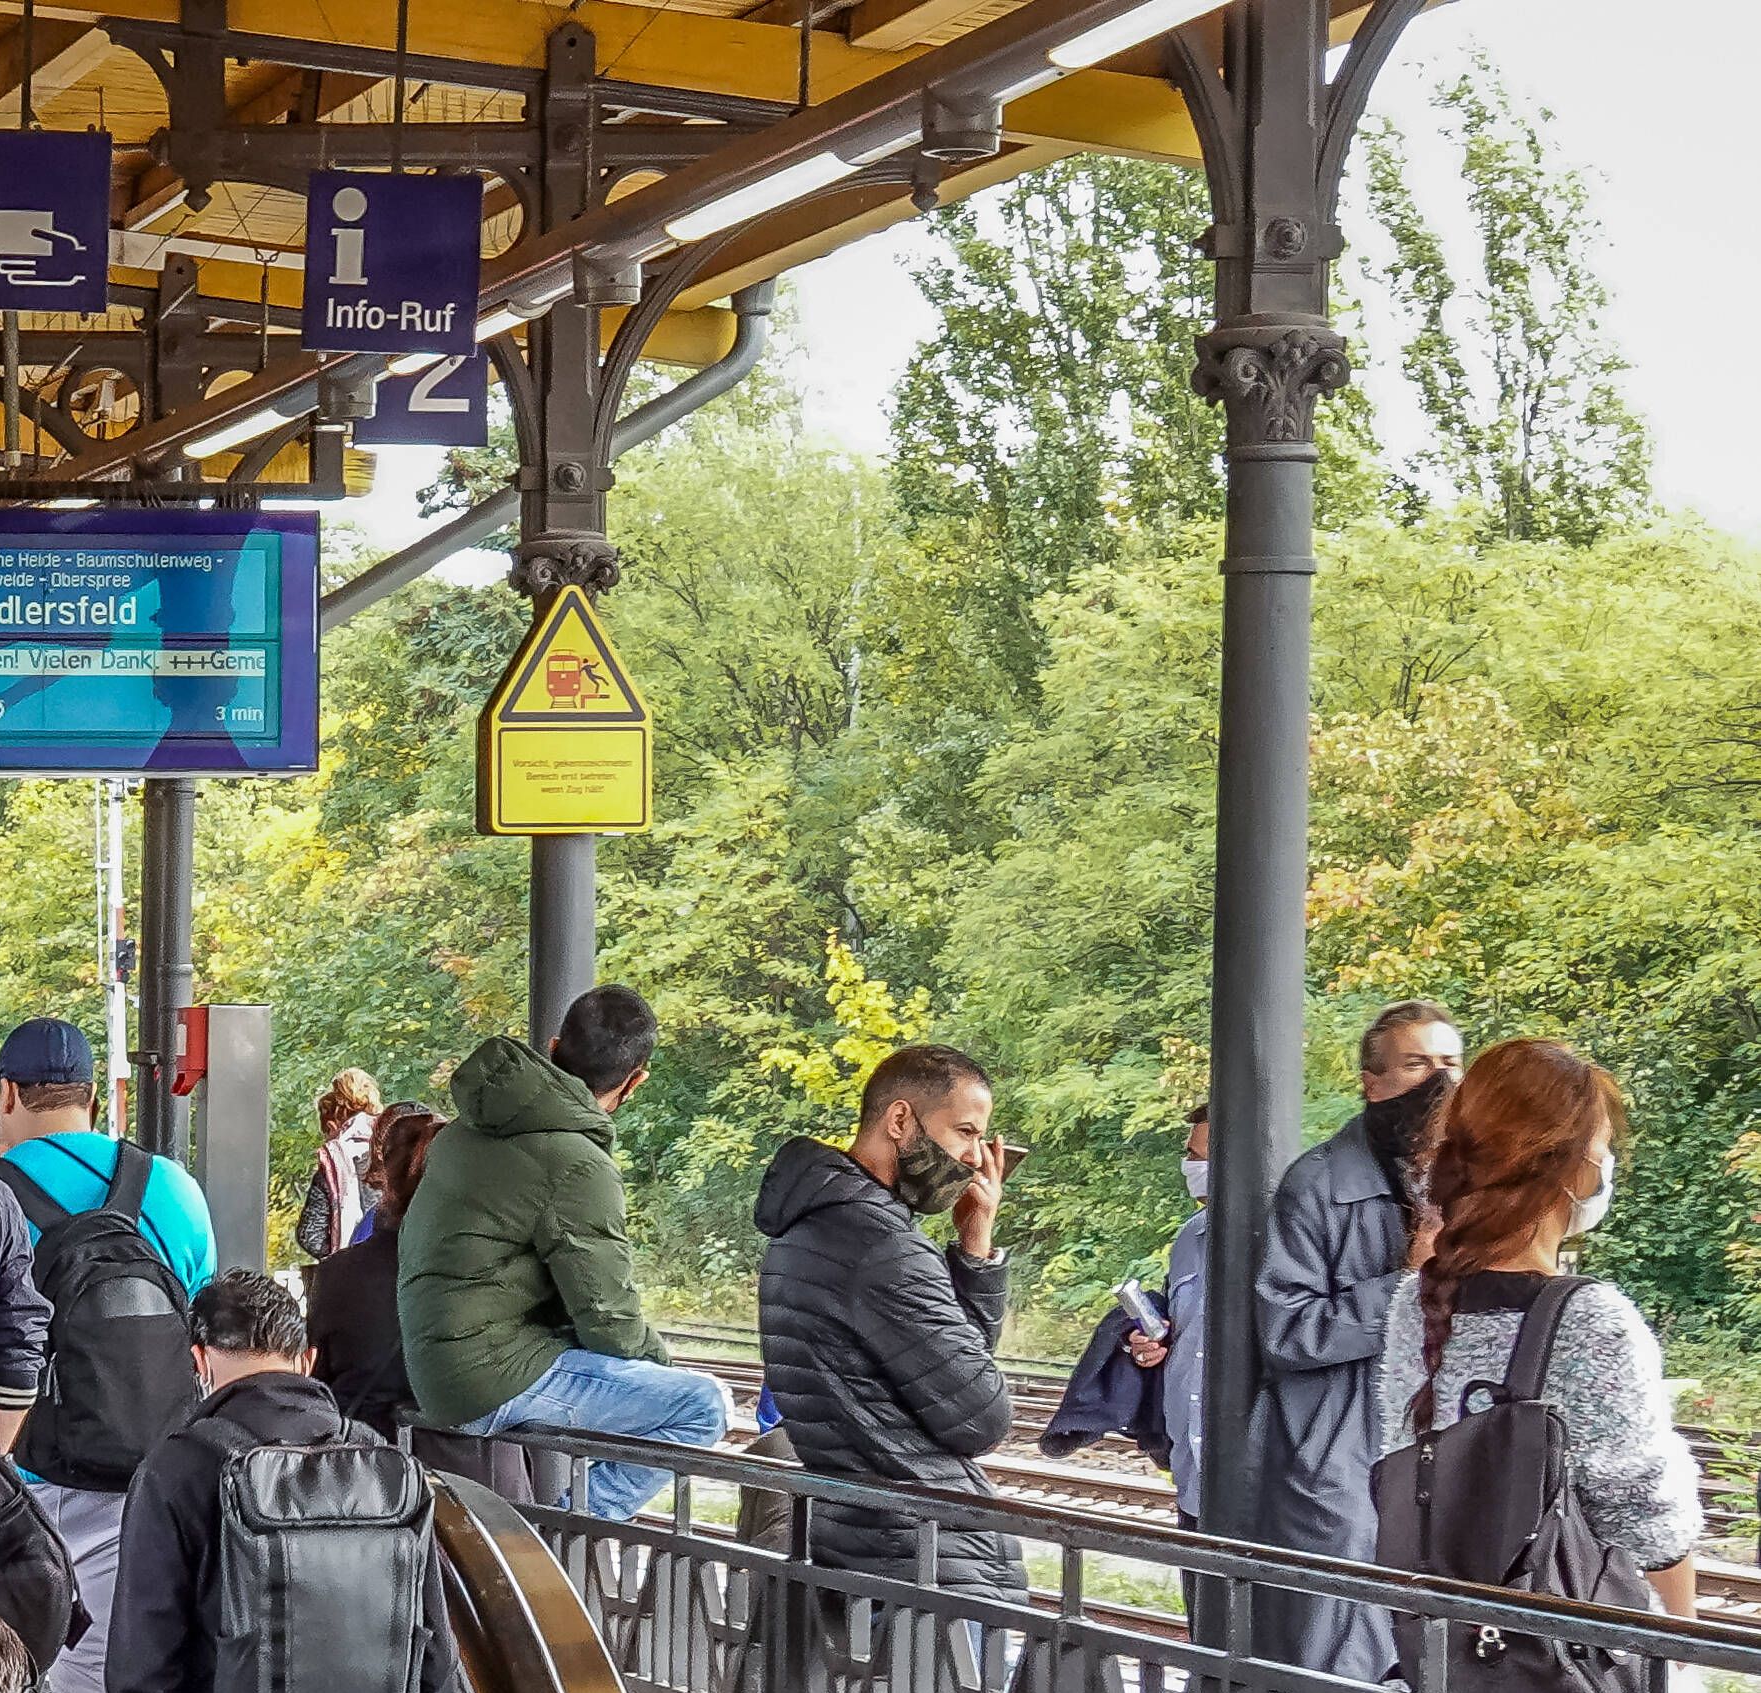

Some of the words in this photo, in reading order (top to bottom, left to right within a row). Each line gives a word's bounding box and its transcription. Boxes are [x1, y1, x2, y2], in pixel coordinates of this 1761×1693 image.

[327, 298, 455, 334] Info-Ruf
[18, 552, 61, 568] Heide
[76, 552, 212, 573] Baumschulenweg
[51, 572, 131, 591] Oberspree
[29, 650, 91, 669] Vielen
[101, 650, 160, 670] Dank.
[215, 706, 226, 721] 3
[232, 706, 264, 721] min
